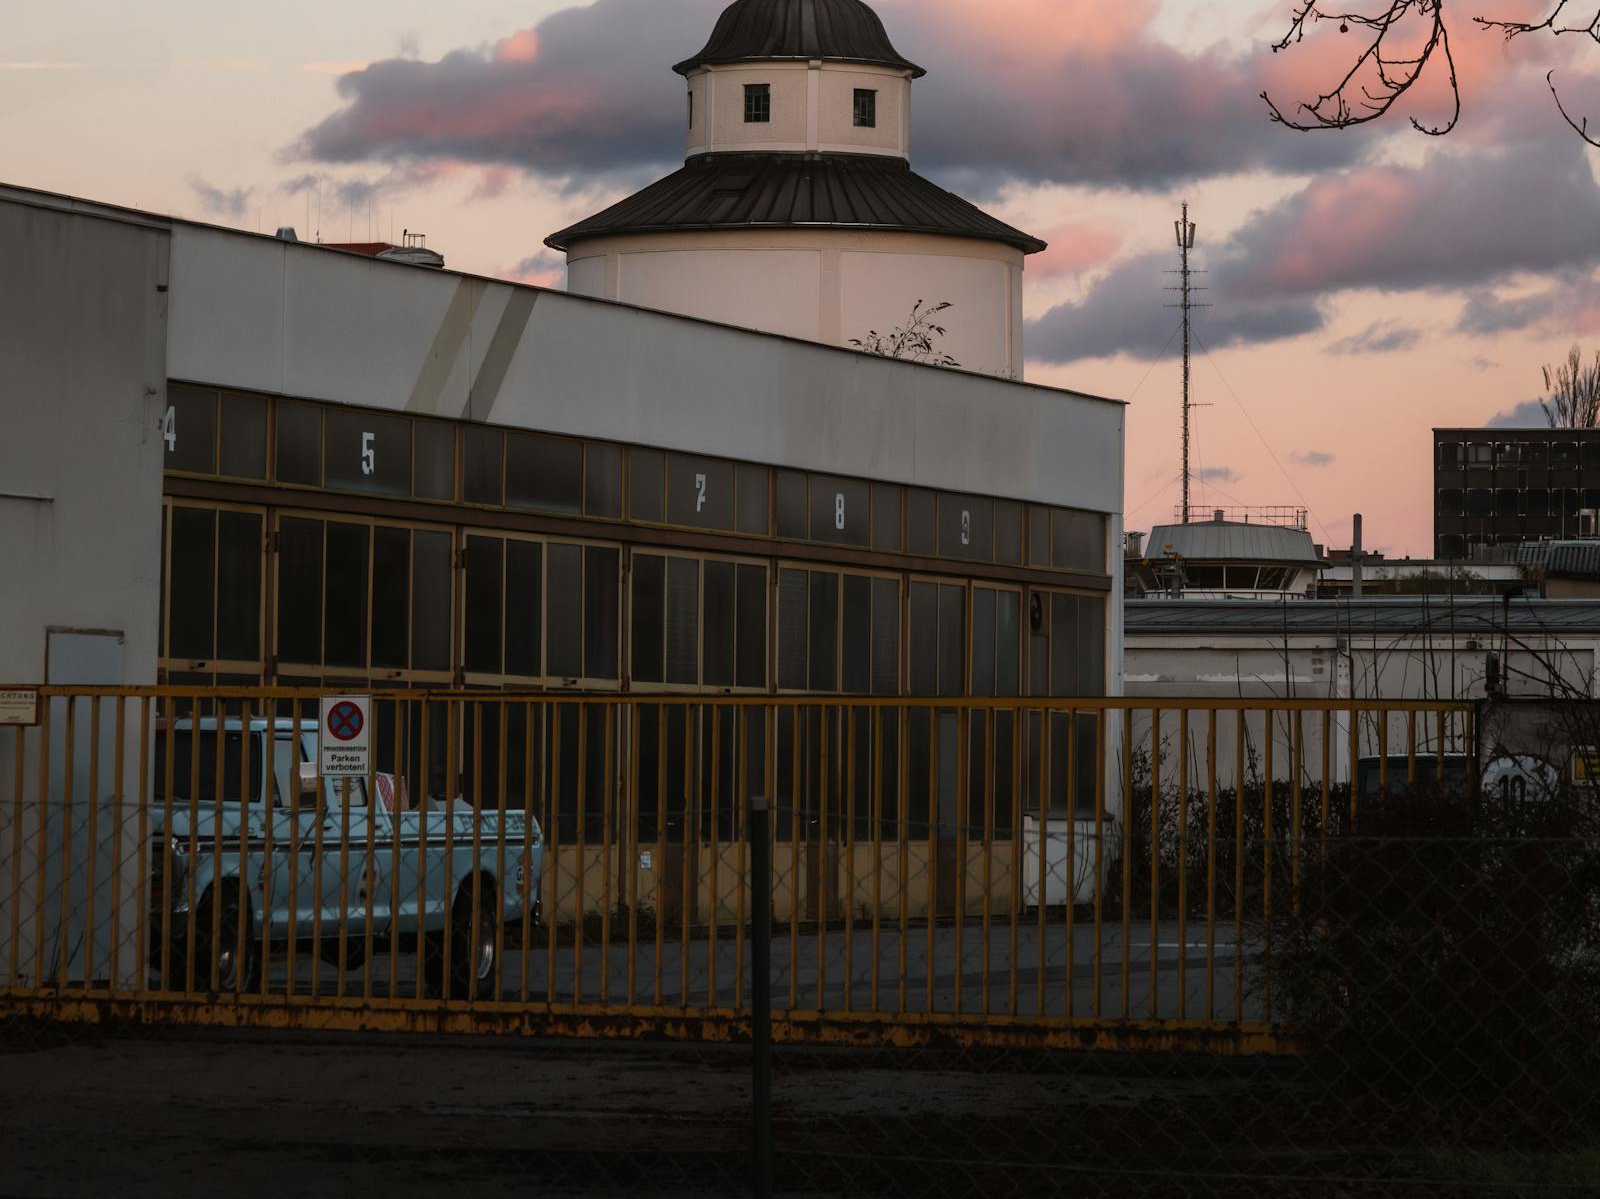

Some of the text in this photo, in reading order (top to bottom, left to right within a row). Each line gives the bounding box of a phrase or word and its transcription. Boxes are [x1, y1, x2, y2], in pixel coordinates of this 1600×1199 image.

[164, 405, 176, 452] 4
[362, 432, 375, 475] 5
[695, 473, 706, 512] 7
[835, 492, 845, 530] 8
[961, 509, 970, 545] 9
[331, 754, 360, 762] Parken
